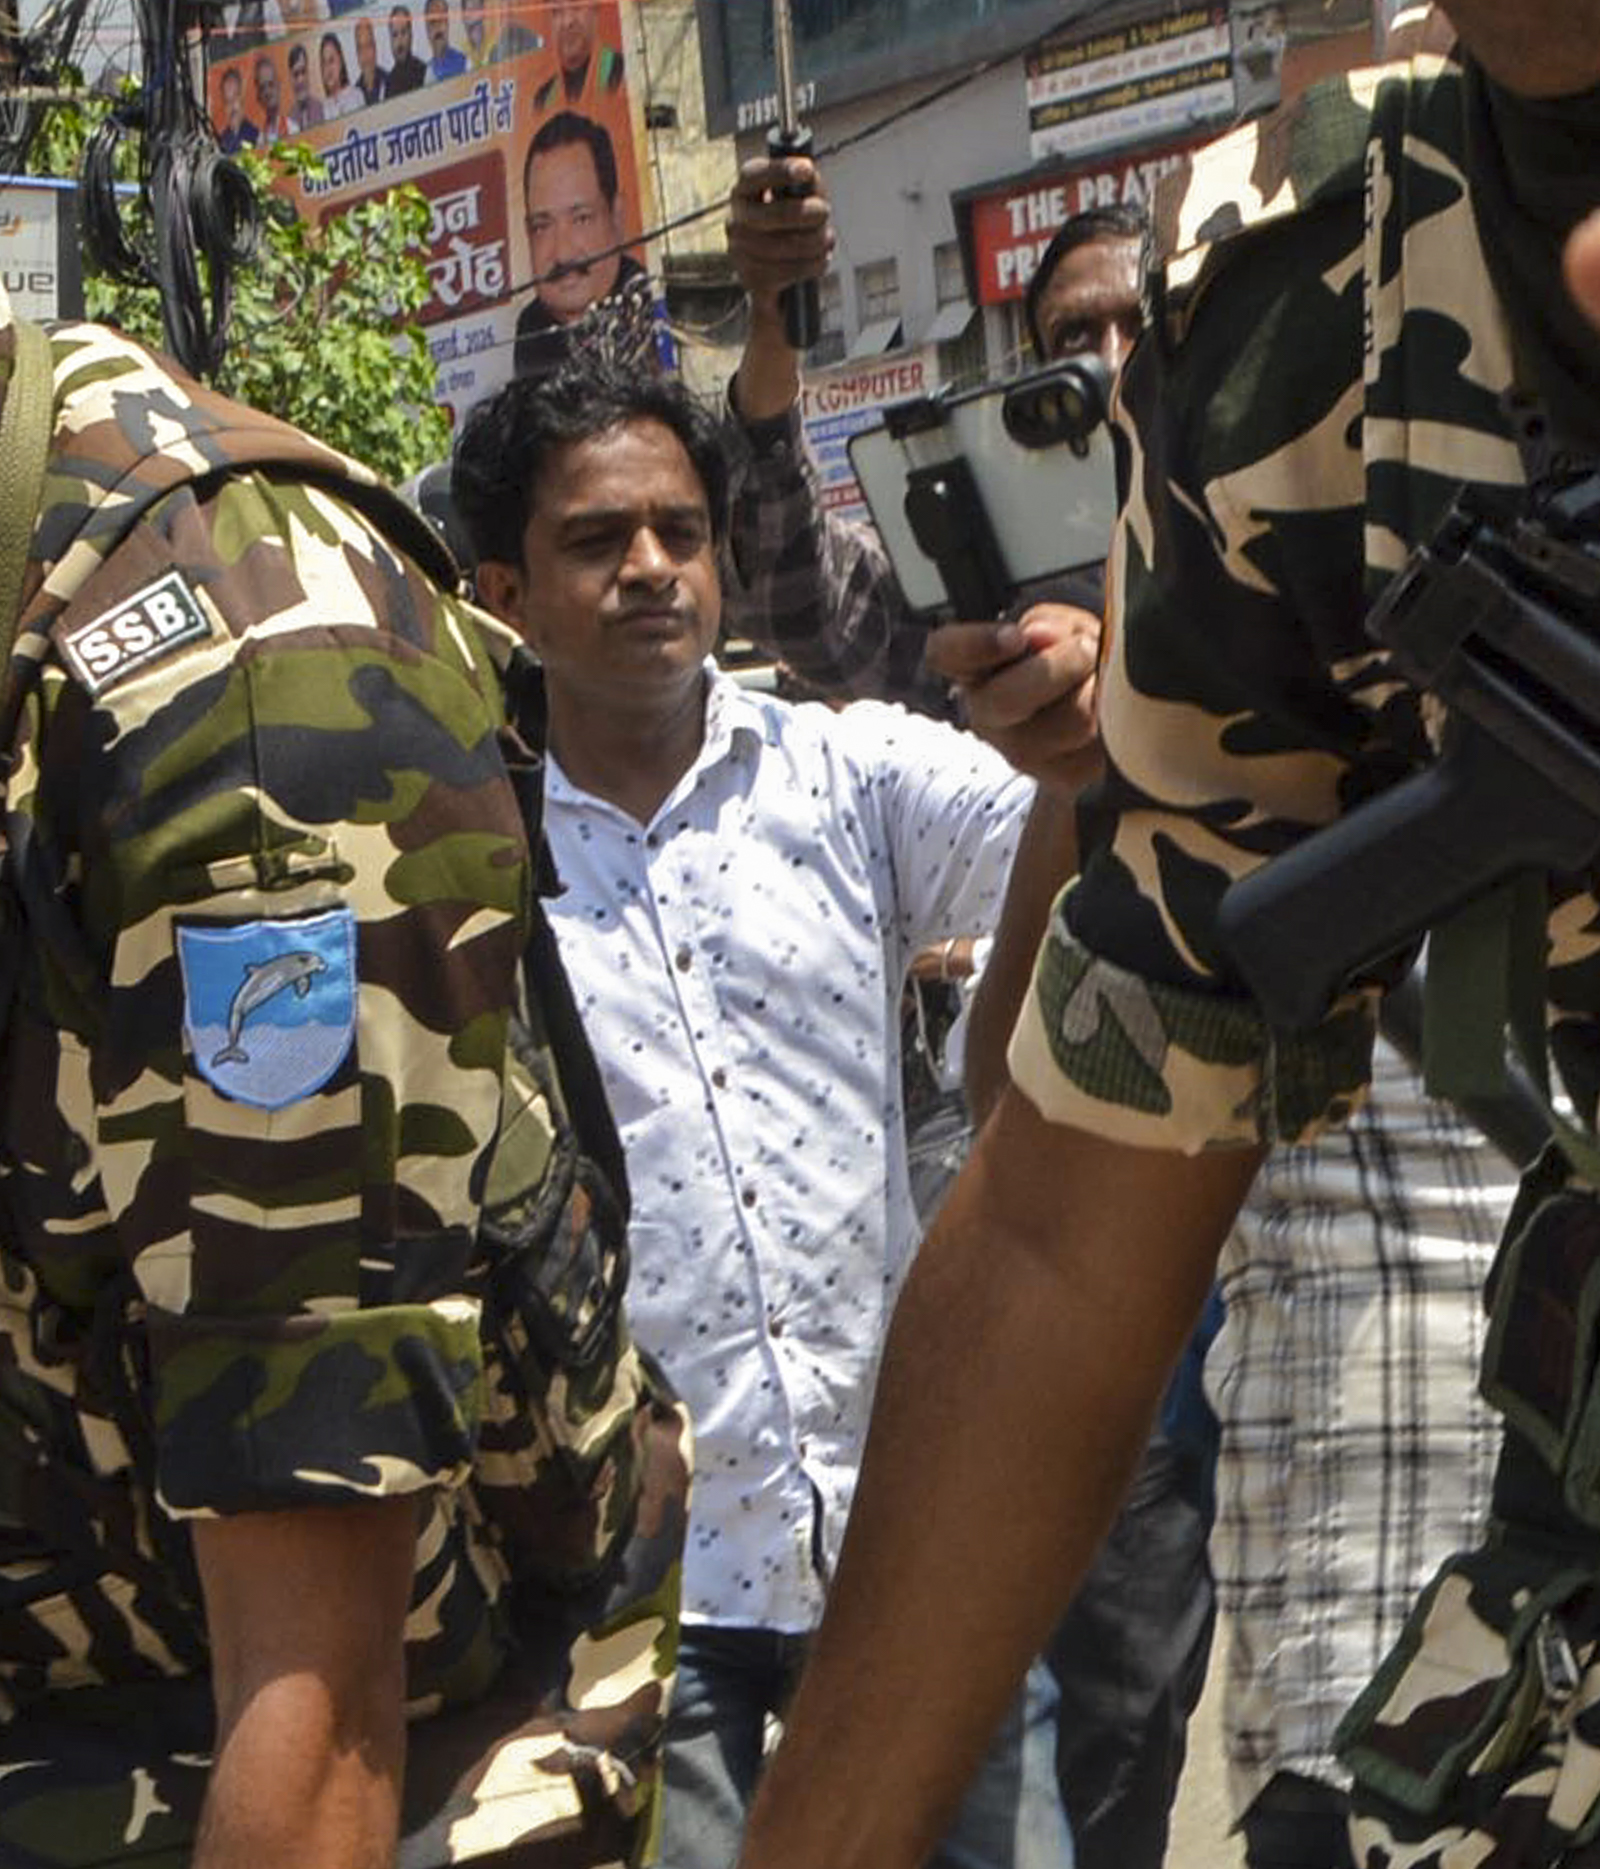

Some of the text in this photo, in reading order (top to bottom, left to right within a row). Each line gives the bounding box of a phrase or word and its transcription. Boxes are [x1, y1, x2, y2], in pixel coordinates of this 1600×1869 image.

[1006, 188, 1067, 237] THE
[816, 361, 924, 414] COMPUTER
[79, 591, 196, 674] S.S.B.
